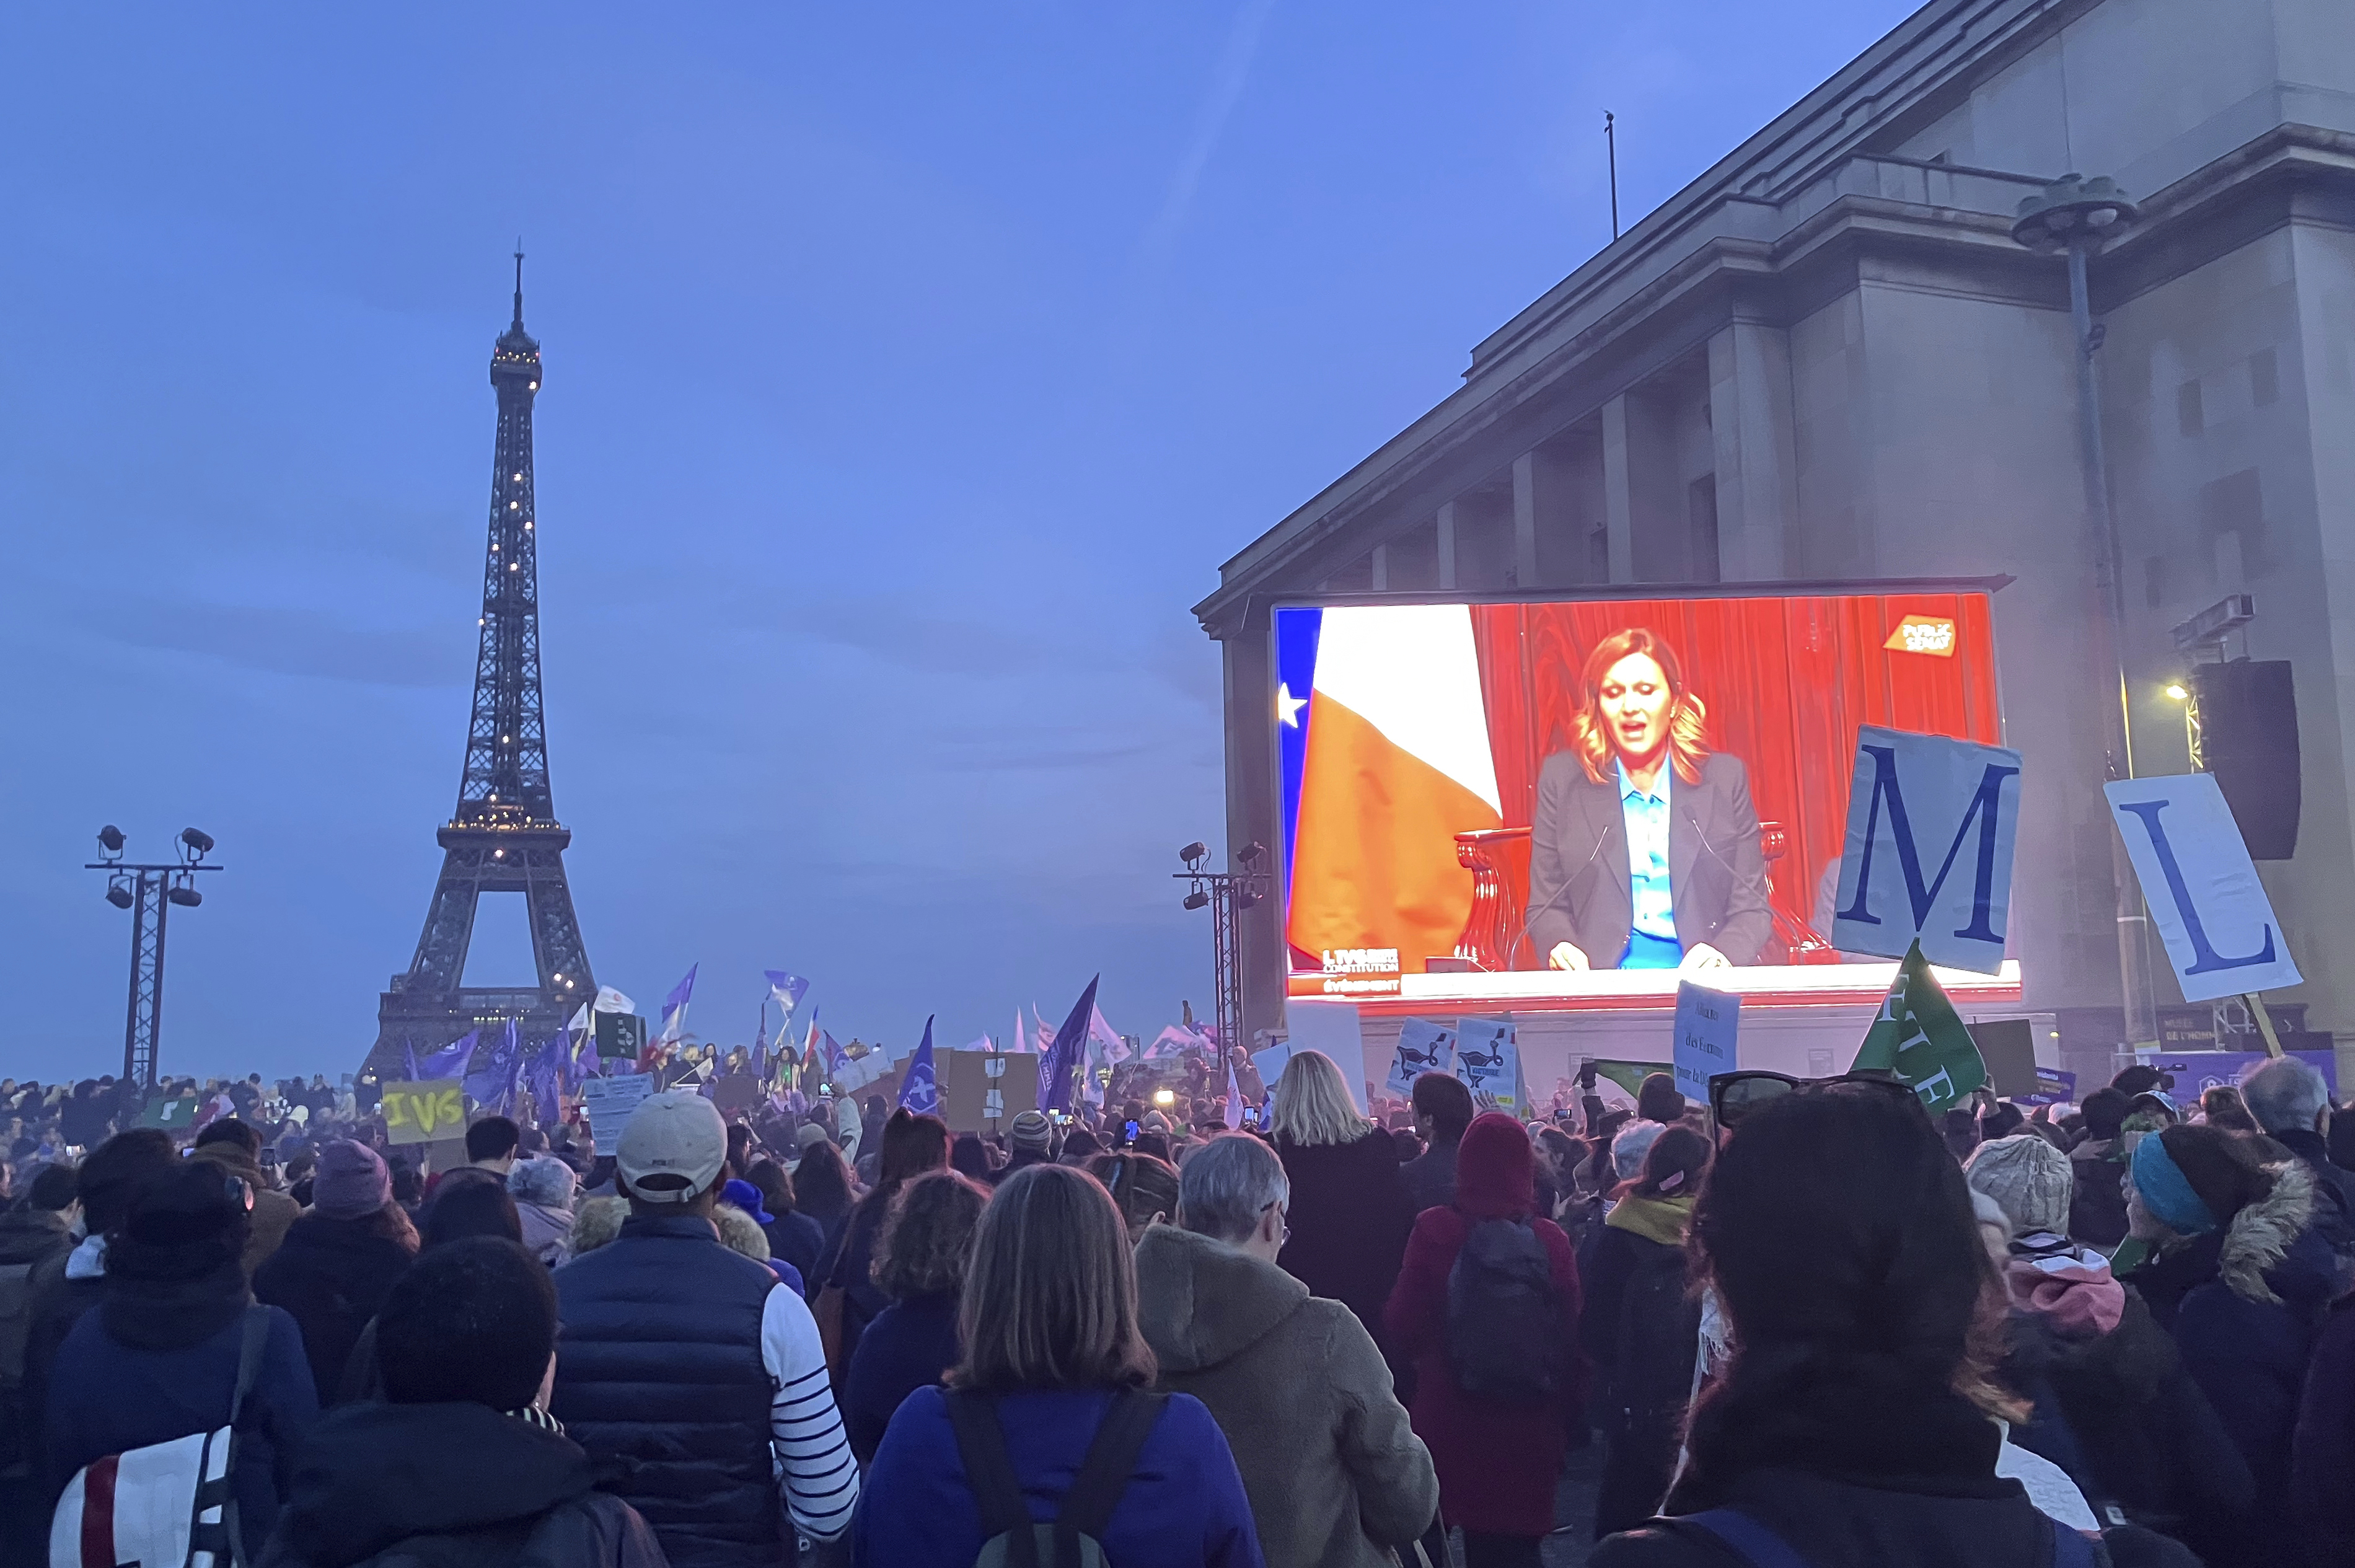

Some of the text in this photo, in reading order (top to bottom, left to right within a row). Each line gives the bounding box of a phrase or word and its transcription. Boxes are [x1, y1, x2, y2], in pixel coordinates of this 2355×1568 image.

[1837, 744, 2020, 944] M
[2119, 799, 2276, 975] L
[383, 1088, 464, 1133] IVG
